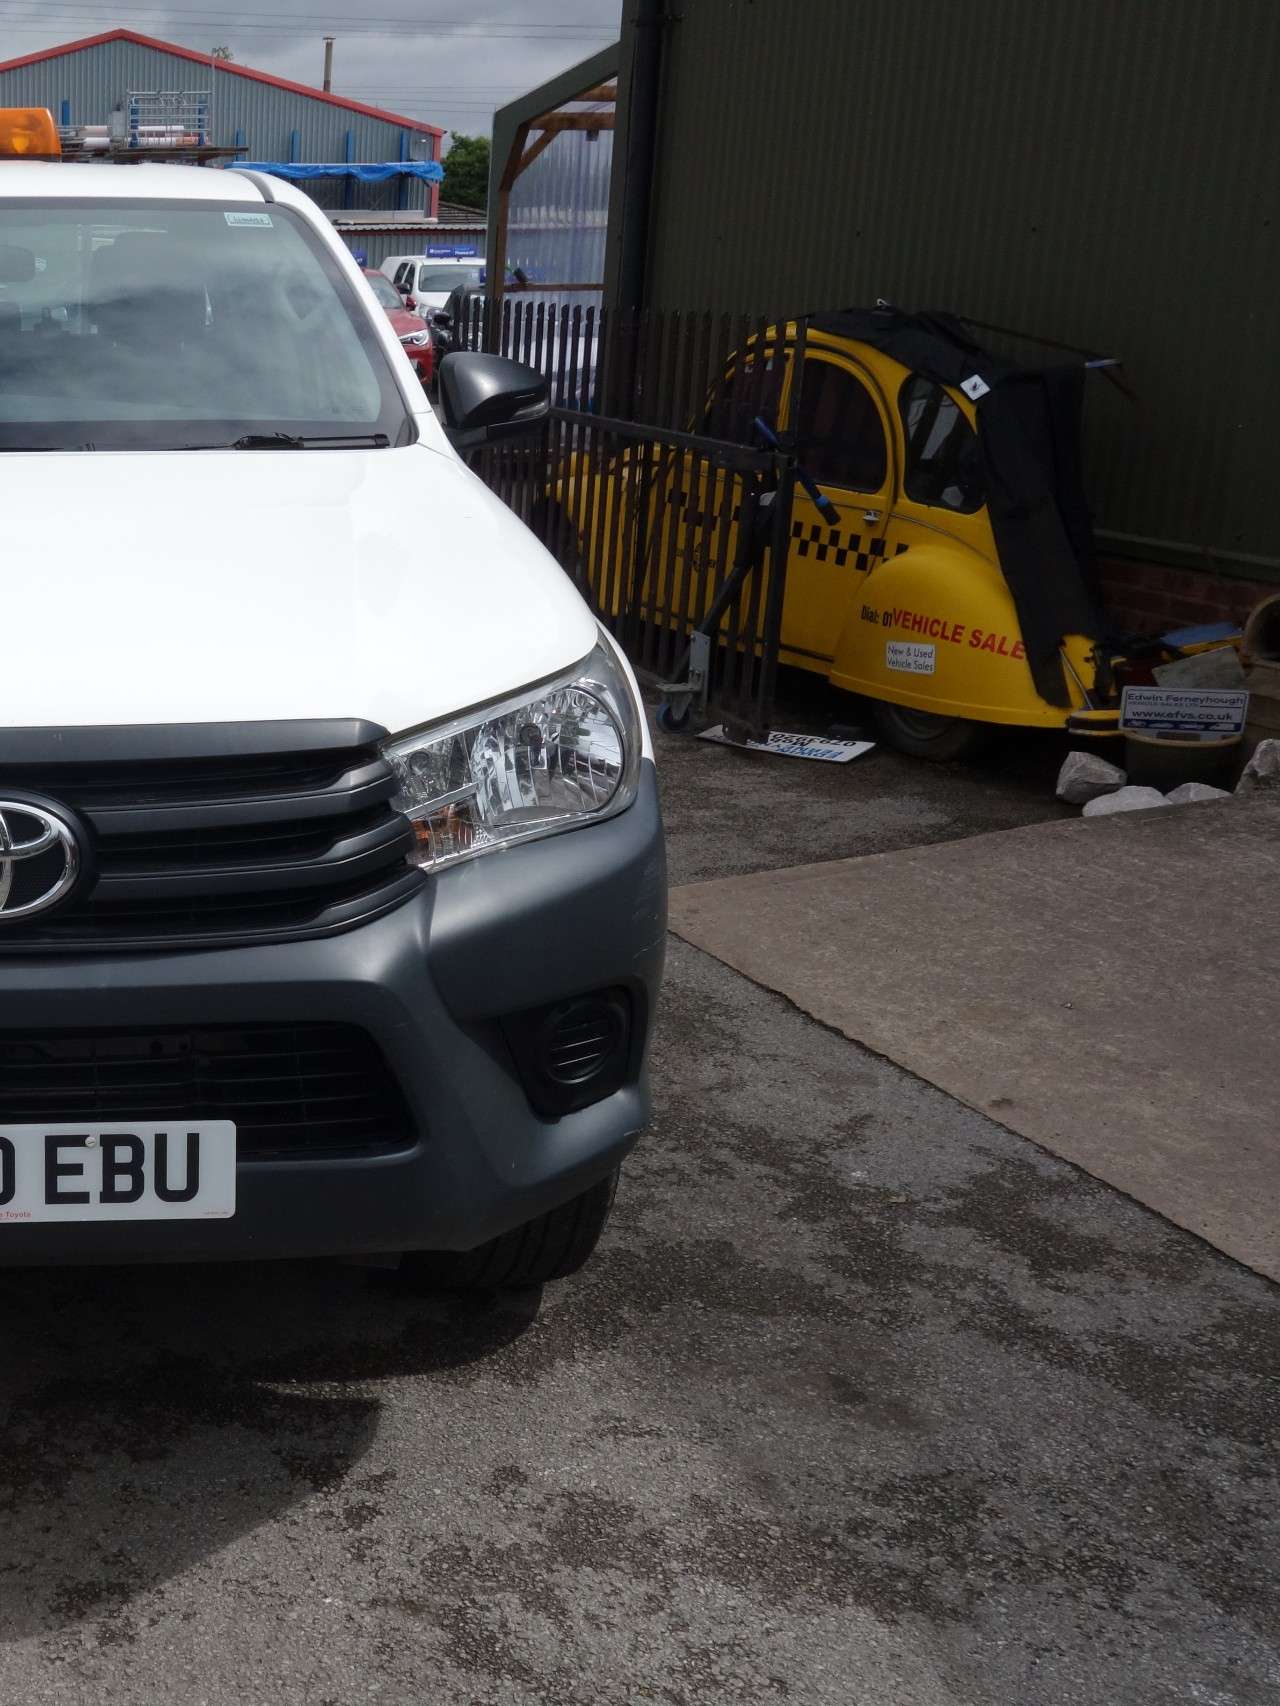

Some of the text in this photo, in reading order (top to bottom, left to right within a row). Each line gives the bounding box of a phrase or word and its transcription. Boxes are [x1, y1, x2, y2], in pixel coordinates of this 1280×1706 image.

[892, 608, 966, 643] VEHICLE
[888, 645, 904, 655] New
[914, 647, 934, 658] Used
[888, 657, 934, 672] Vehicle Sales
[44, 1132, 200, 1205] EBU
[6, 1211, 32, 1219] Toyota
